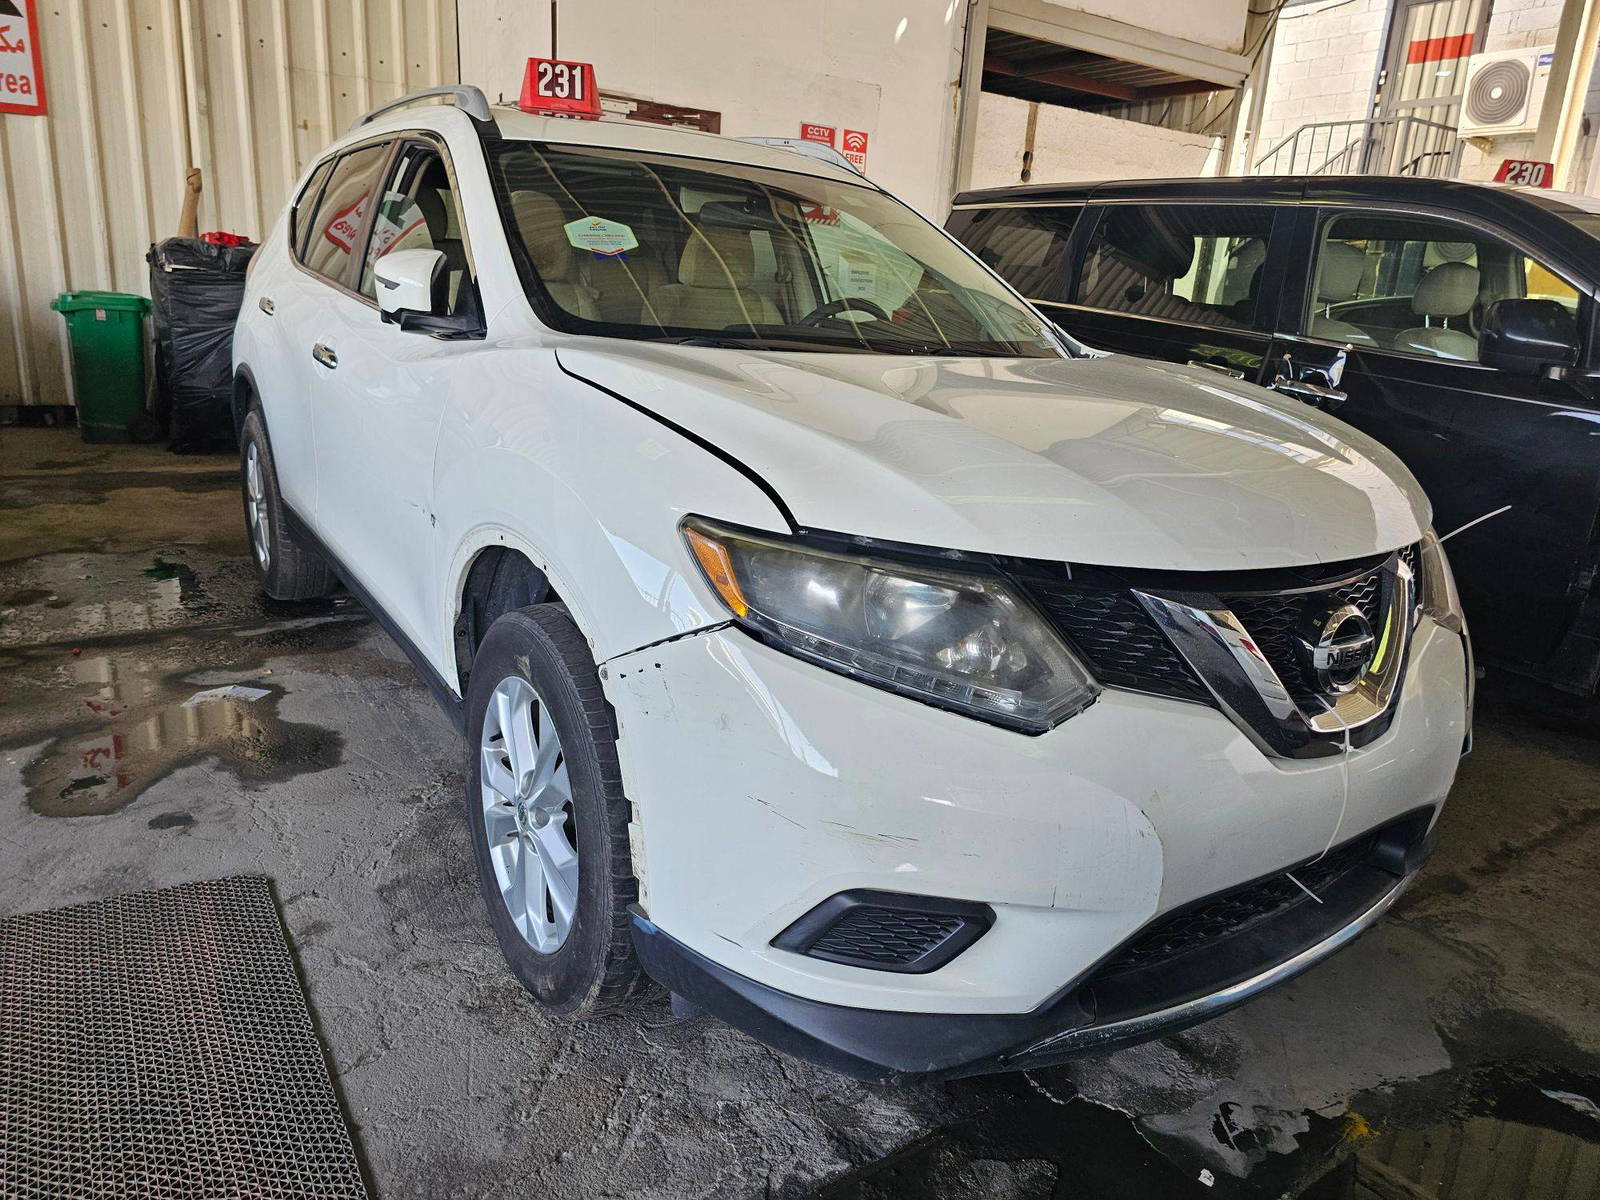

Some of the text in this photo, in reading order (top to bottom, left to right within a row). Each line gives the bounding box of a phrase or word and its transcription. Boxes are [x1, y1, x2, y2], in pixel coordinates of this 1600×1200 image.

[538, 62, 583, 100] 231
[807, 126, 830, 137] CCTV
[1505, 161, 1546, 186] 230
